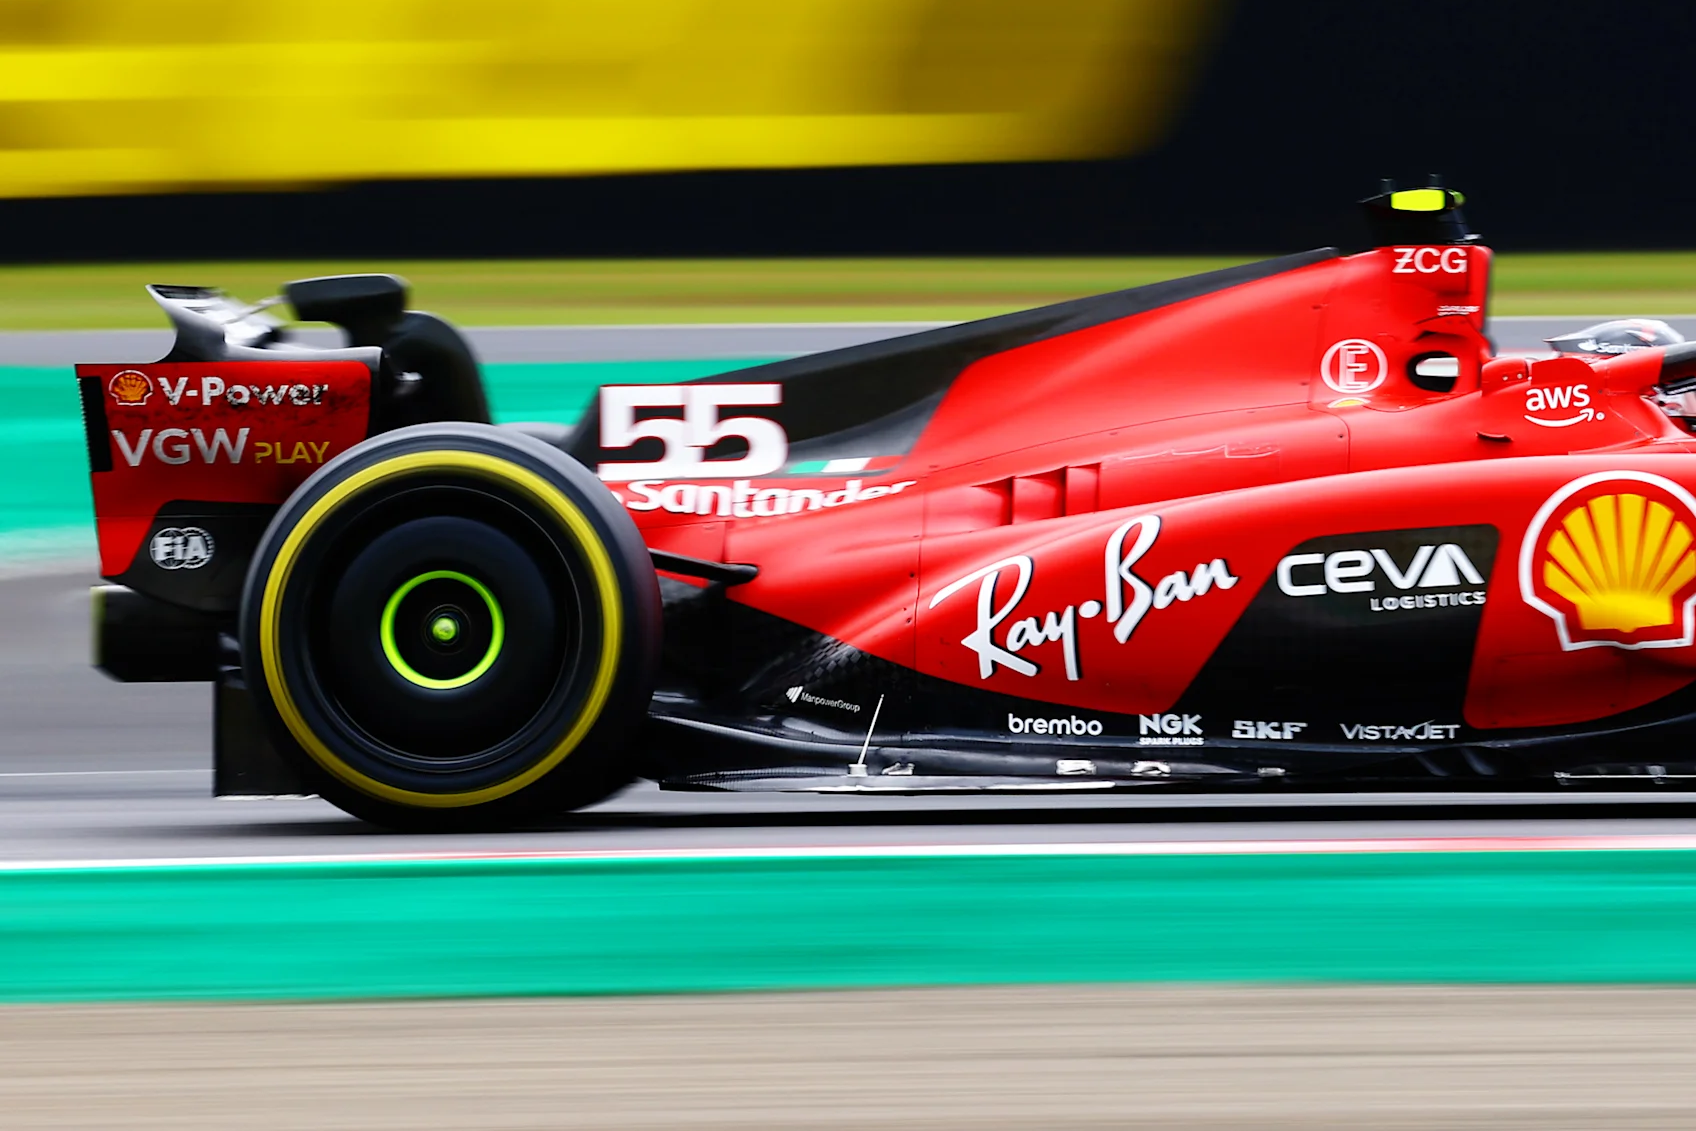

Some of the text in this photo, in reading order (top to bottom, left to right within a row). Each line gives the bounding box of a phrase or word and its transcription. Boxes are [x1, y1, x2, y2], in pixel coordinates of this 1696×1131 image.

[158, 377, 328, 405] V-Power
[1526, 384, 1590, 412] aws
[597, 382, 788, 481] 55
[111, 427, 330, 467] VGW PLAY
[627, 479, 917, 518] Santander
[1370, 591, 1487, 611] LOGISTICS
[800, 692, 861, 713] ManpowerGroup
[1008, 713, 1103, 736] brembo
[1139, 713, 1203, 735] NGK
[1232, 720, 1308, 739] SKF
